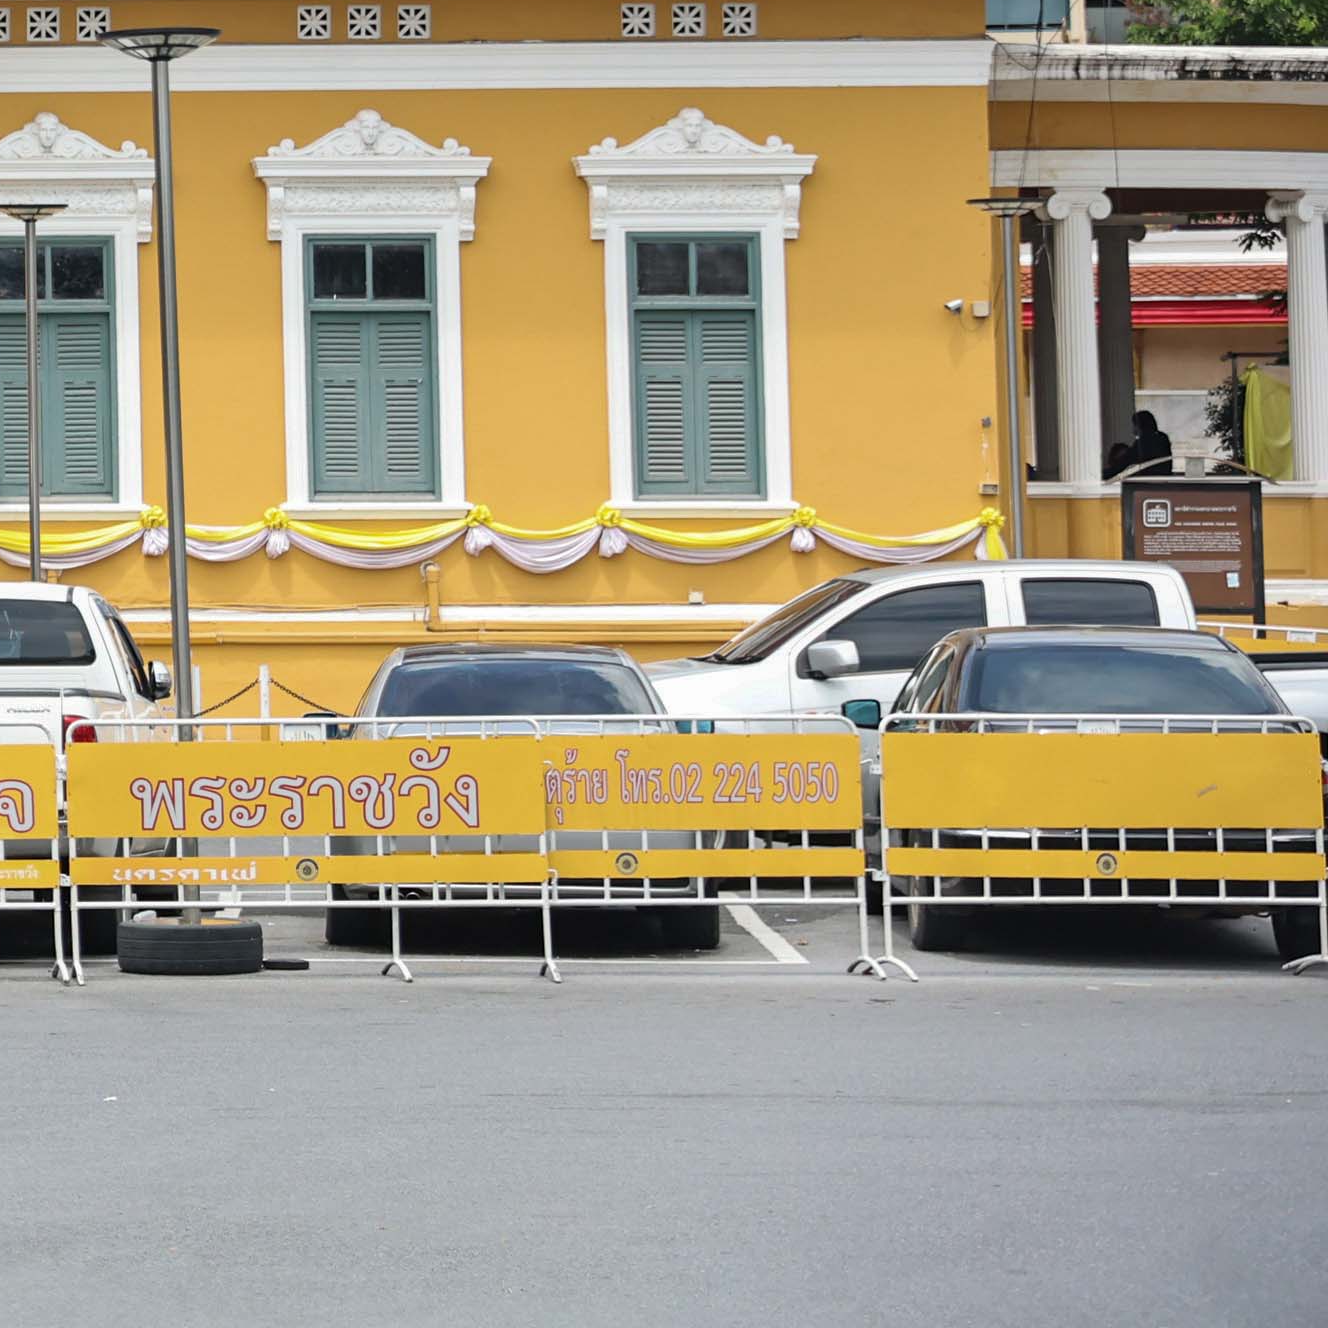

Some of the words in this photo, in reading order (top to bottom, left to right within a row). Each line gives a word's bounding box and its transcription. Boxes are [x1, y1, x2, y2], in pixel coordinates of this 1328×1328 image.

[129, 746, 481, 831] พระราชวัง
[713, 762, 763, 803] 224
[772, 762, 840, 803] 5050
